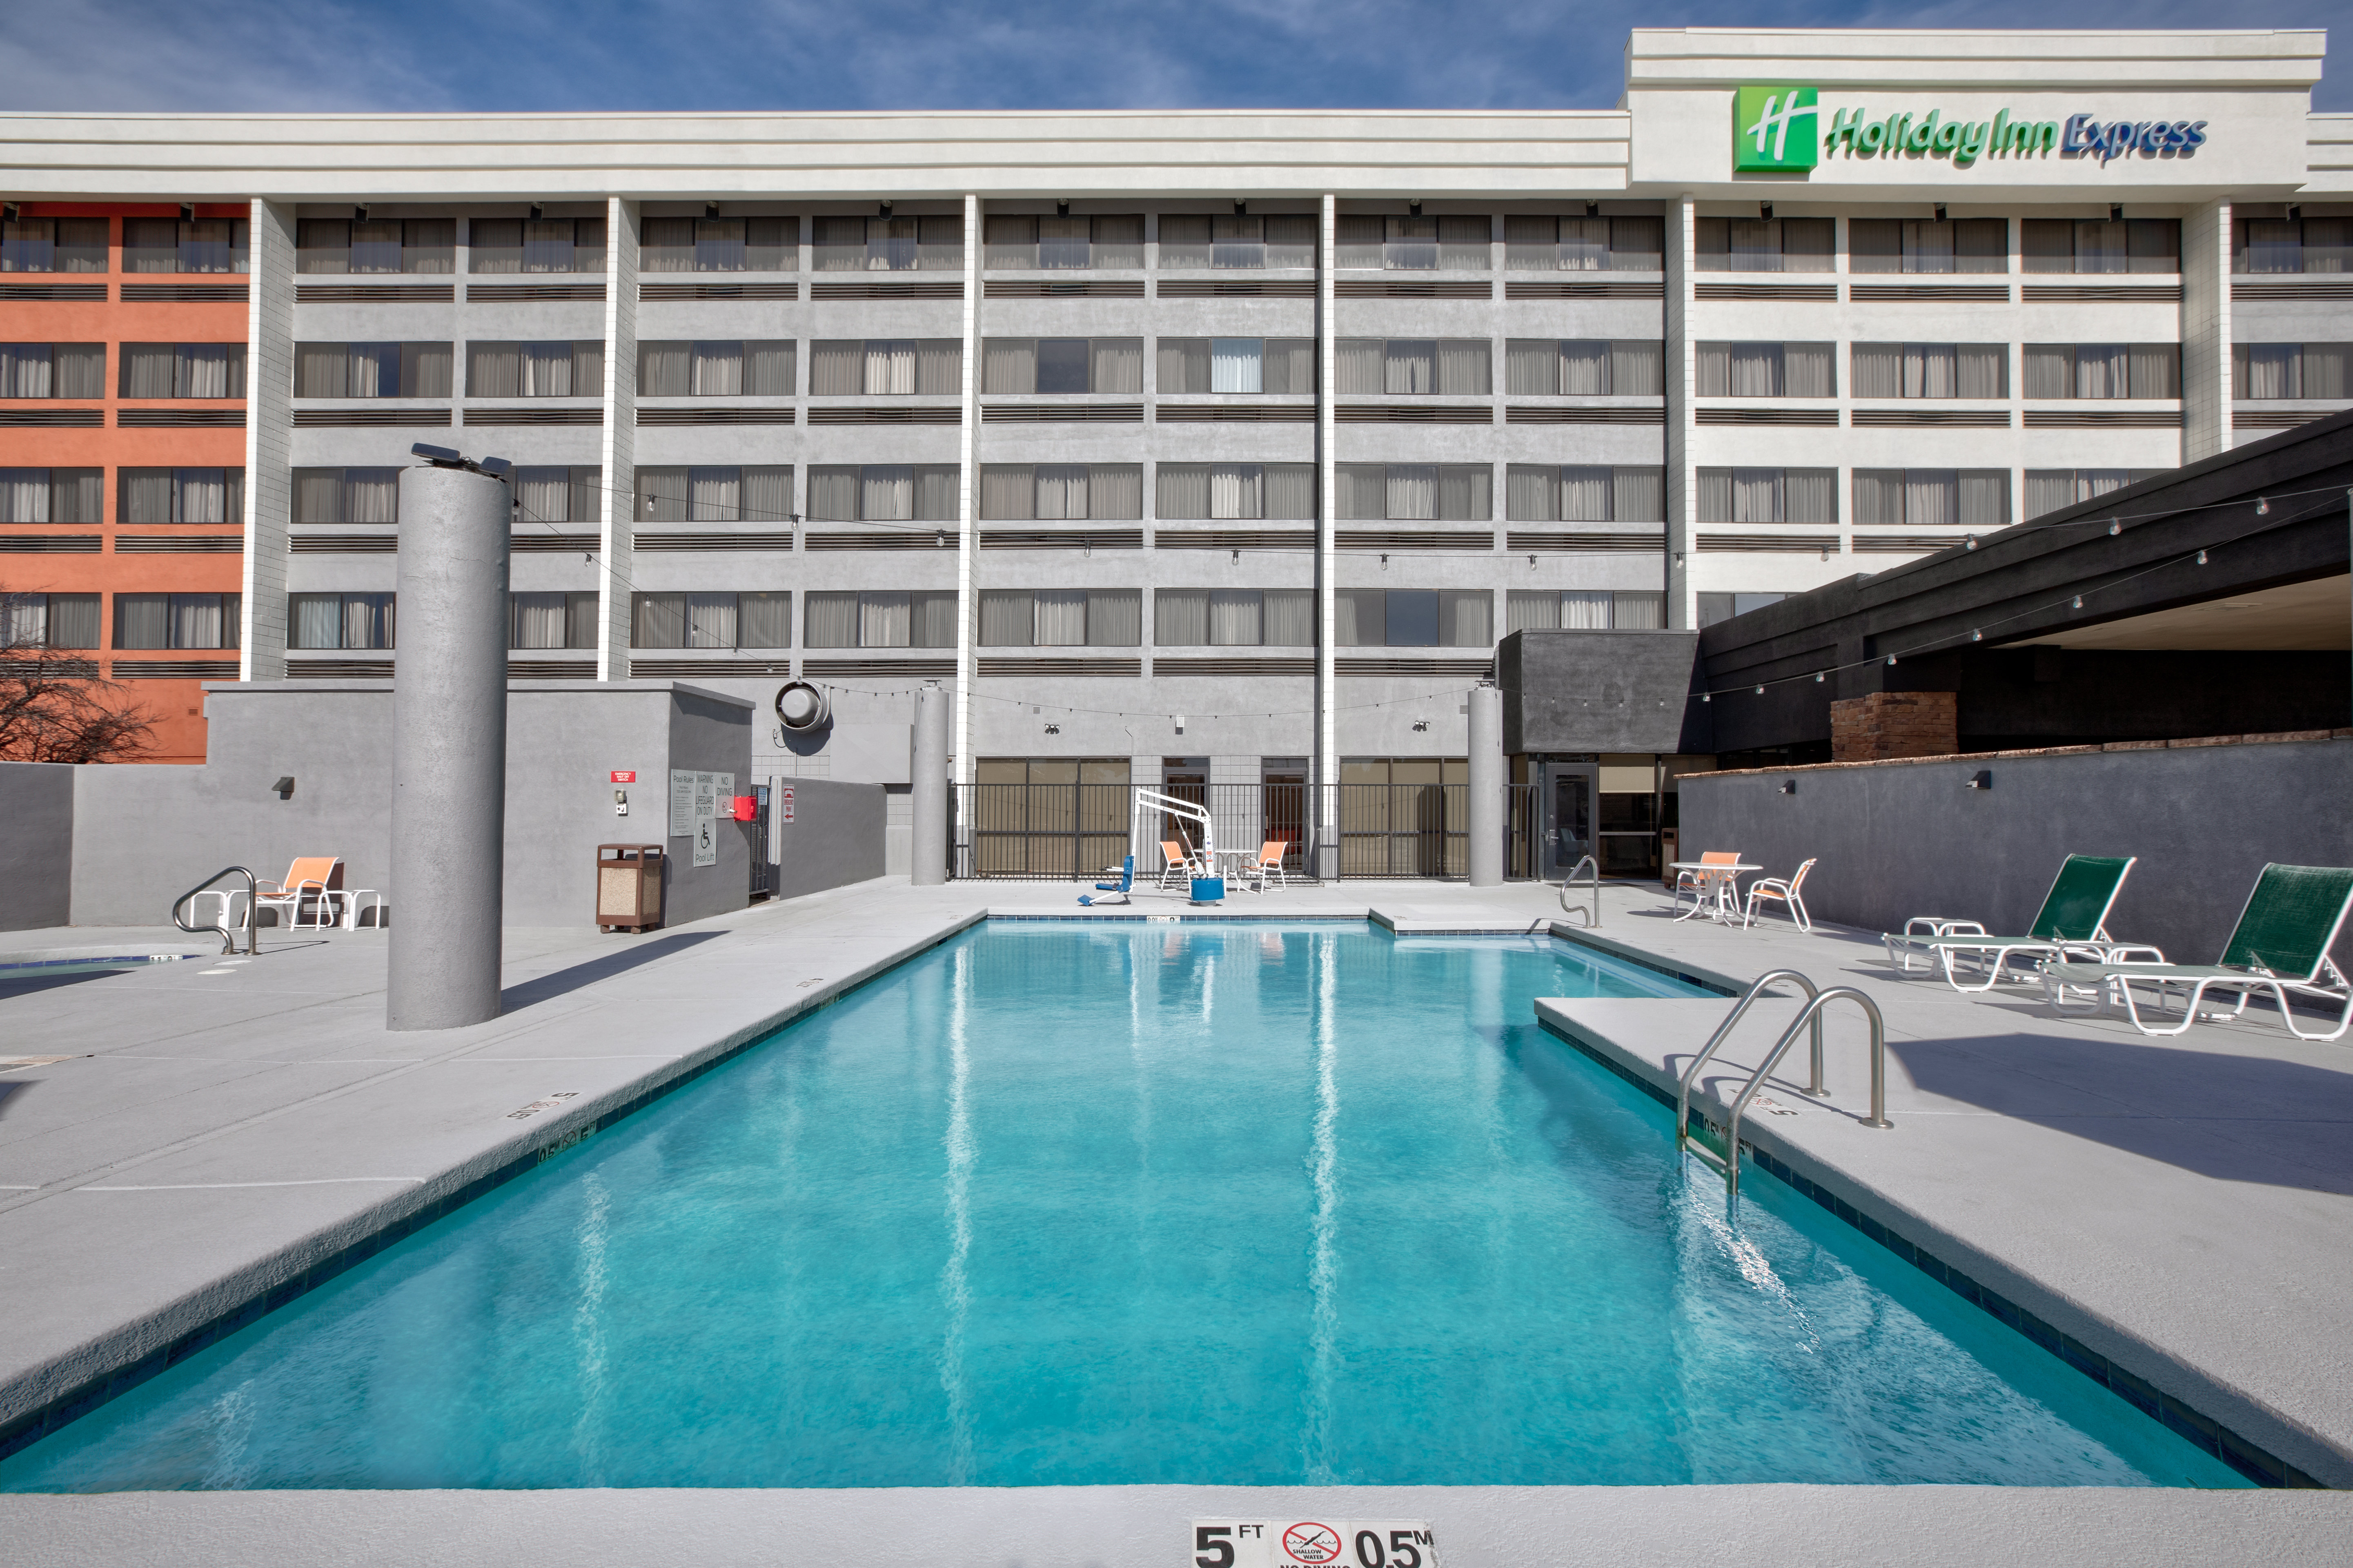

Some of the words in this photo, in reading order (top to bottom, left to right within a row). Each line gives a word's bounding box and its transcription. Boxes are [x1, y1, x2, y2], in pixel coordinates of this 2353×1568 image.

[2062, 113, 2208, 161] Express
[697, 774, 713, 784] WARNING
[721, 777, 728, 785] NO
[703, 785, 708, 794] NO
[717, 787, 732, 796] DIVING
[696, 796, 714, 804] LIFEGUARD
[697, 806, 703, 815] ON
[703, 806, 712, 815] DUTY
[696, 853, 706, 862] Pool
[580, 1125, 588, 1141] 5
[590, 1120, 596, 1131] FT
[1745, 1140, 1752, 1151] FT
[1196, 1526, 1235, 1568] 5
[1239, 1524, 1264, 1538] FT
